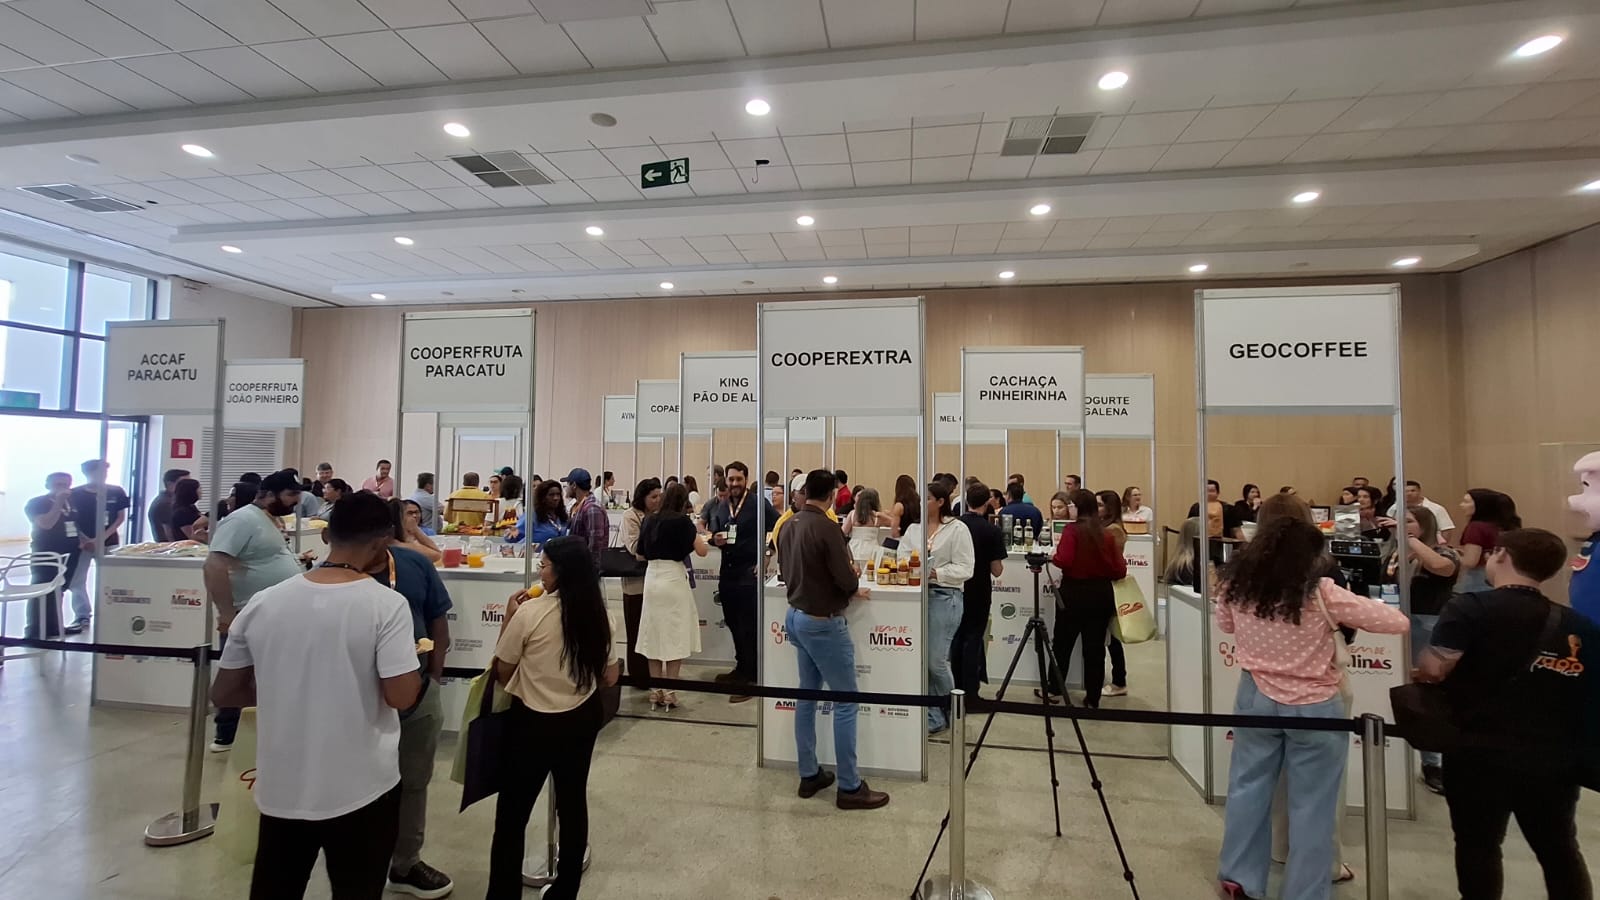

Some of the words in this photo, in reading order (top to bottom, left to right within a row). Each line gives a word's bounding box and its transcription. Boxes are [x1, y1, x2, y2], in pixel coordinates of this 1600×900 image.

[410, 345, 523, 360] COOPERFRUTA
[1229, 342, 1368, 359] GEOCOFFEE
[141, 353, 186, 366] ACCAF
[771, 350, 913, 367] COOPEREXTRA
[128, 368, 197, 381] PARACATU
[425, 364, 505, 377] PARACATU
[229, 383, 298, 392] COOPERFRUTA
[720, 377, 749, 387] KING
[989, 376, 1057, 389] CACHAÇA
[226, 393, 252, 403] JOÃO
[255, 394, 299, 404] PINHEIRO
[693, 390, 719, 402] PÃO
[722, 392, 738, 402] DE
[979, 390, 1067, 401] PINHEIRINHA
